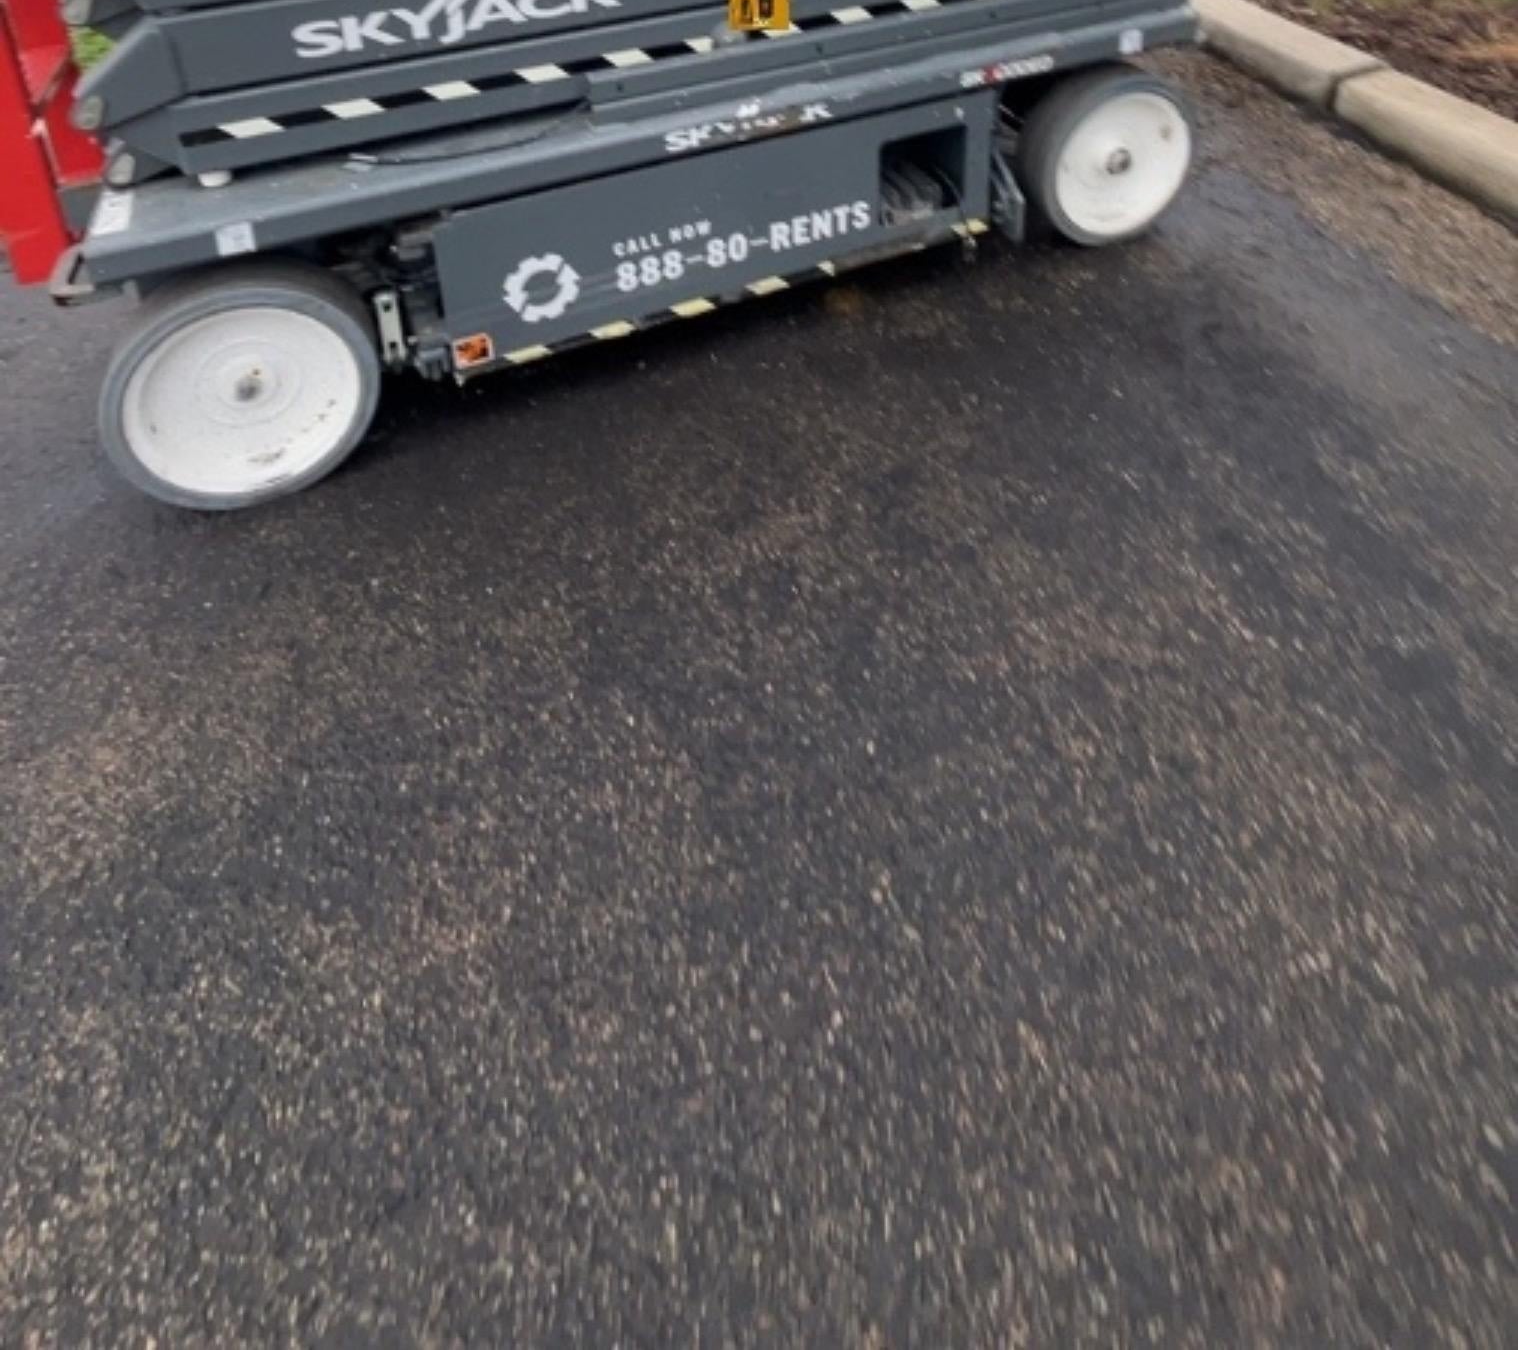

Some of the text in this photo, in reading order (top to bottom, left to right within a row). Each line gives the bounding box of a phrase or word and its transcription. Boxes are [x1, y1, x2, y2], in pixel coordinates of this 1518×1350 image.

[612, 218, 712, 258] CALL NOW
[615, 200, 872, 293] 888-80-RENTS
